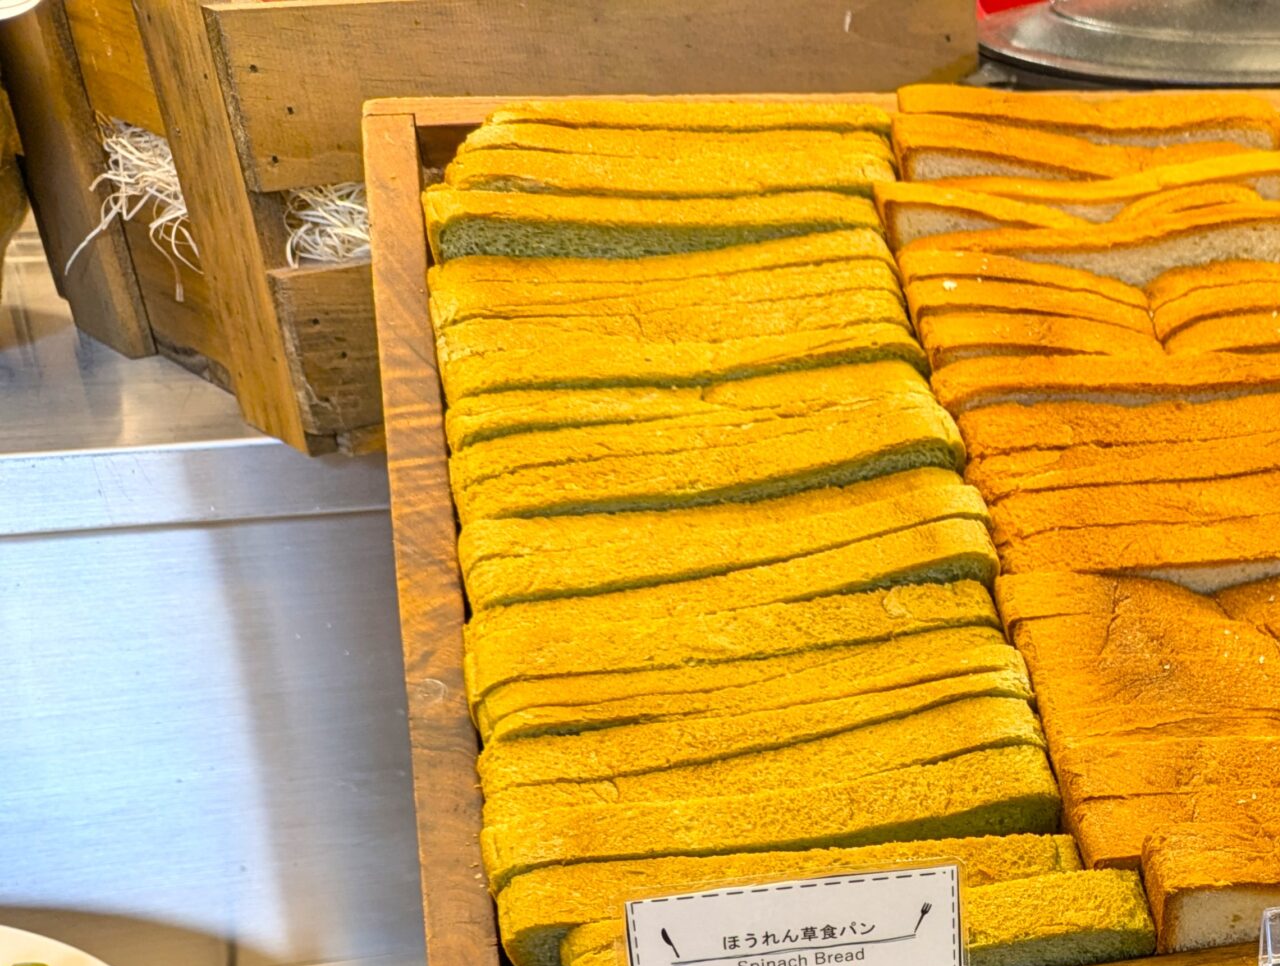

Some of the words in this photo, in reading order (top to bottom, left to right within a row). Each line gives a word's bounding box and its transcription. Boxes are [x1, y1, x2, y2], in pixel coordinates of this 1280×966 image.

[722, 922, 877, 951] ほうれん草食パン
[814, 947, 866, 966] Bread
